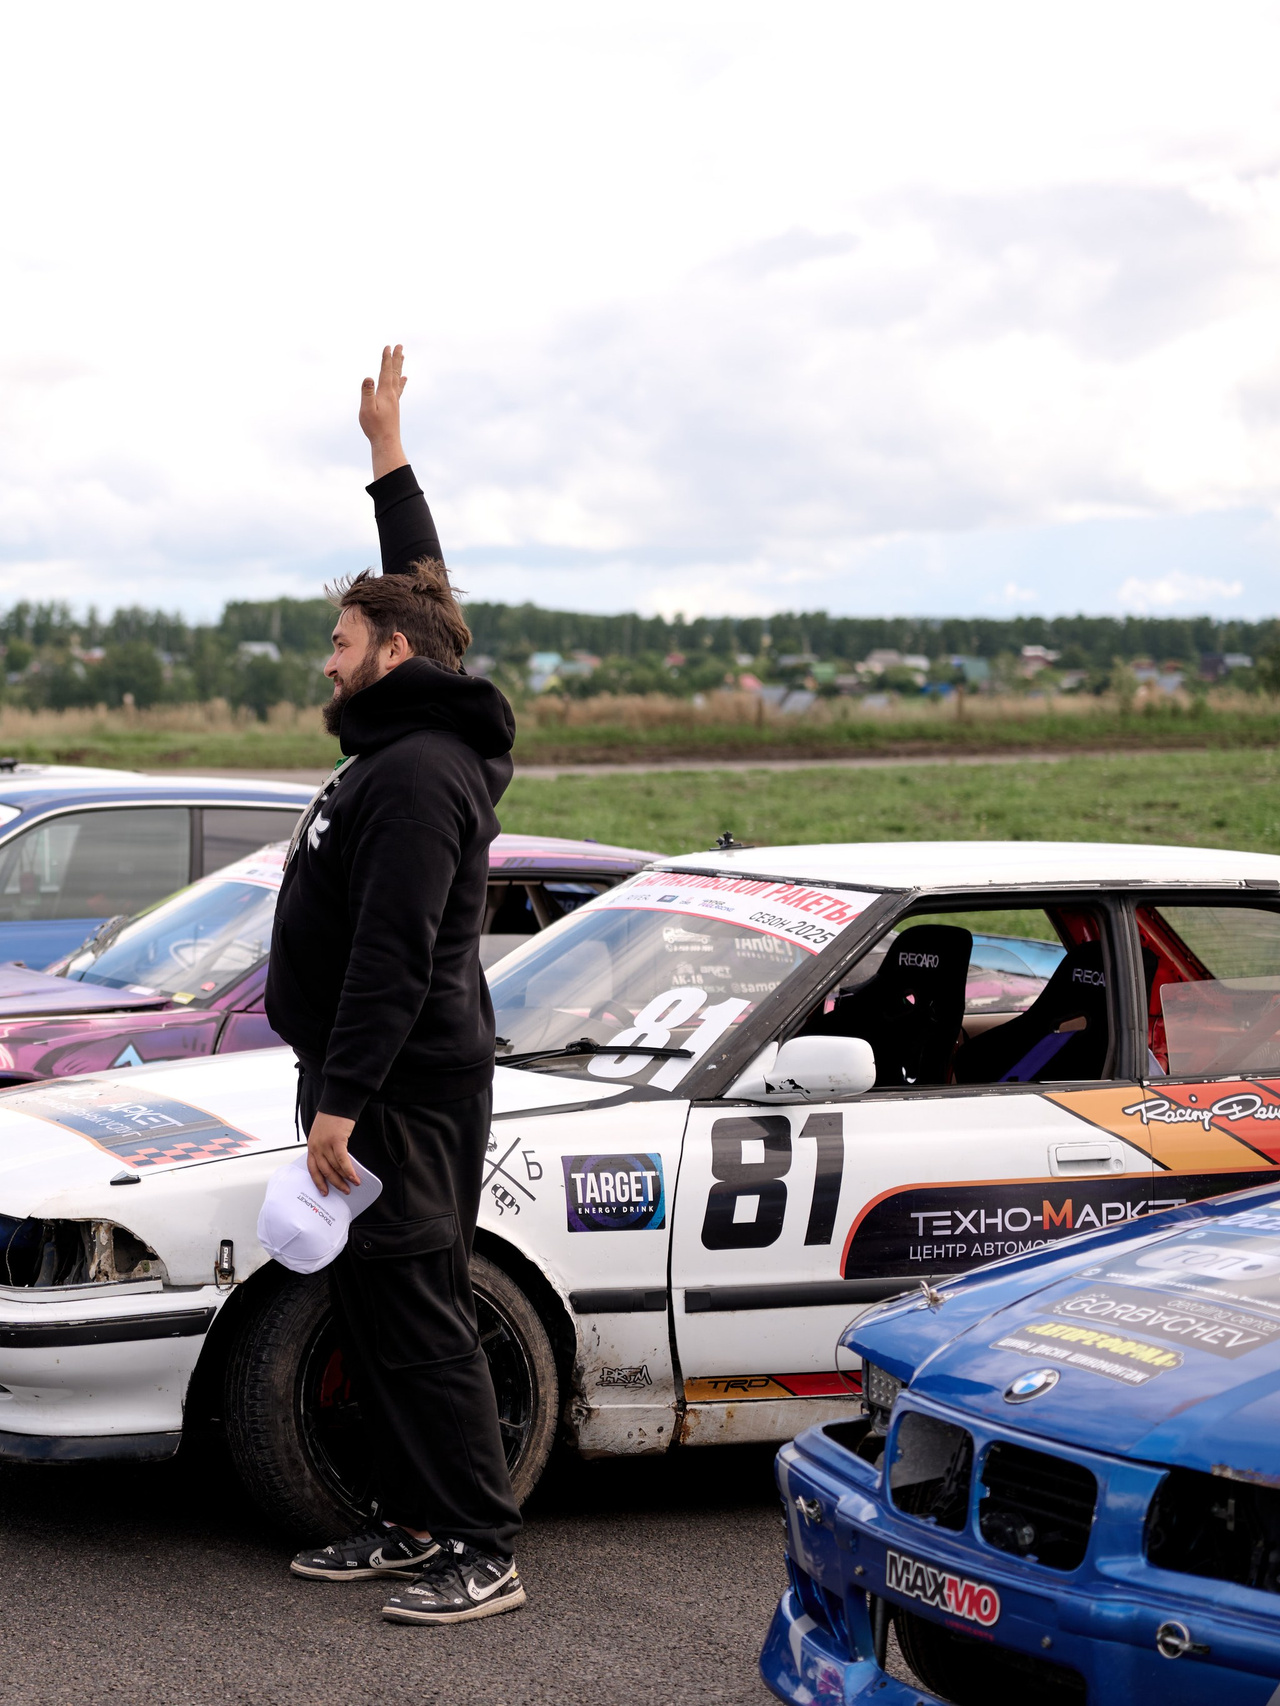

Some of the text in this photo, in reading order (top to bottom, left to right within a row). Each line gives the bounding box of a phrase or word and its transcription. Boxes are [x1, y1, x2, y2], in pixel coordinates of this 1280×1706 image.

[771, 883, 866, 926] РАКЕТЫ
[748, 911, 836, 945] СЕЗОН 2025
[898, 952, 939, 968] RECARO
[1072, 968, 1106, 988] RECA
[587, 987, 751, 1092] 81
[1122, 1093, 1214, 1131] Racing
[570, 1170, 657, 1204] TARGET
[700, 1111, 844, 1251] 81
[578, 1205, 654, 1215] ENERGY DRINK
[909, 1242, 967, 1261] ЦЕНТР
[707, 1378, 770, 1393] TRD
[372, 1556, 382, 1567] 12
[486, 1563, 502, 1579] IMPUL
[885, 1550, 1001, 1627] MAXMO
